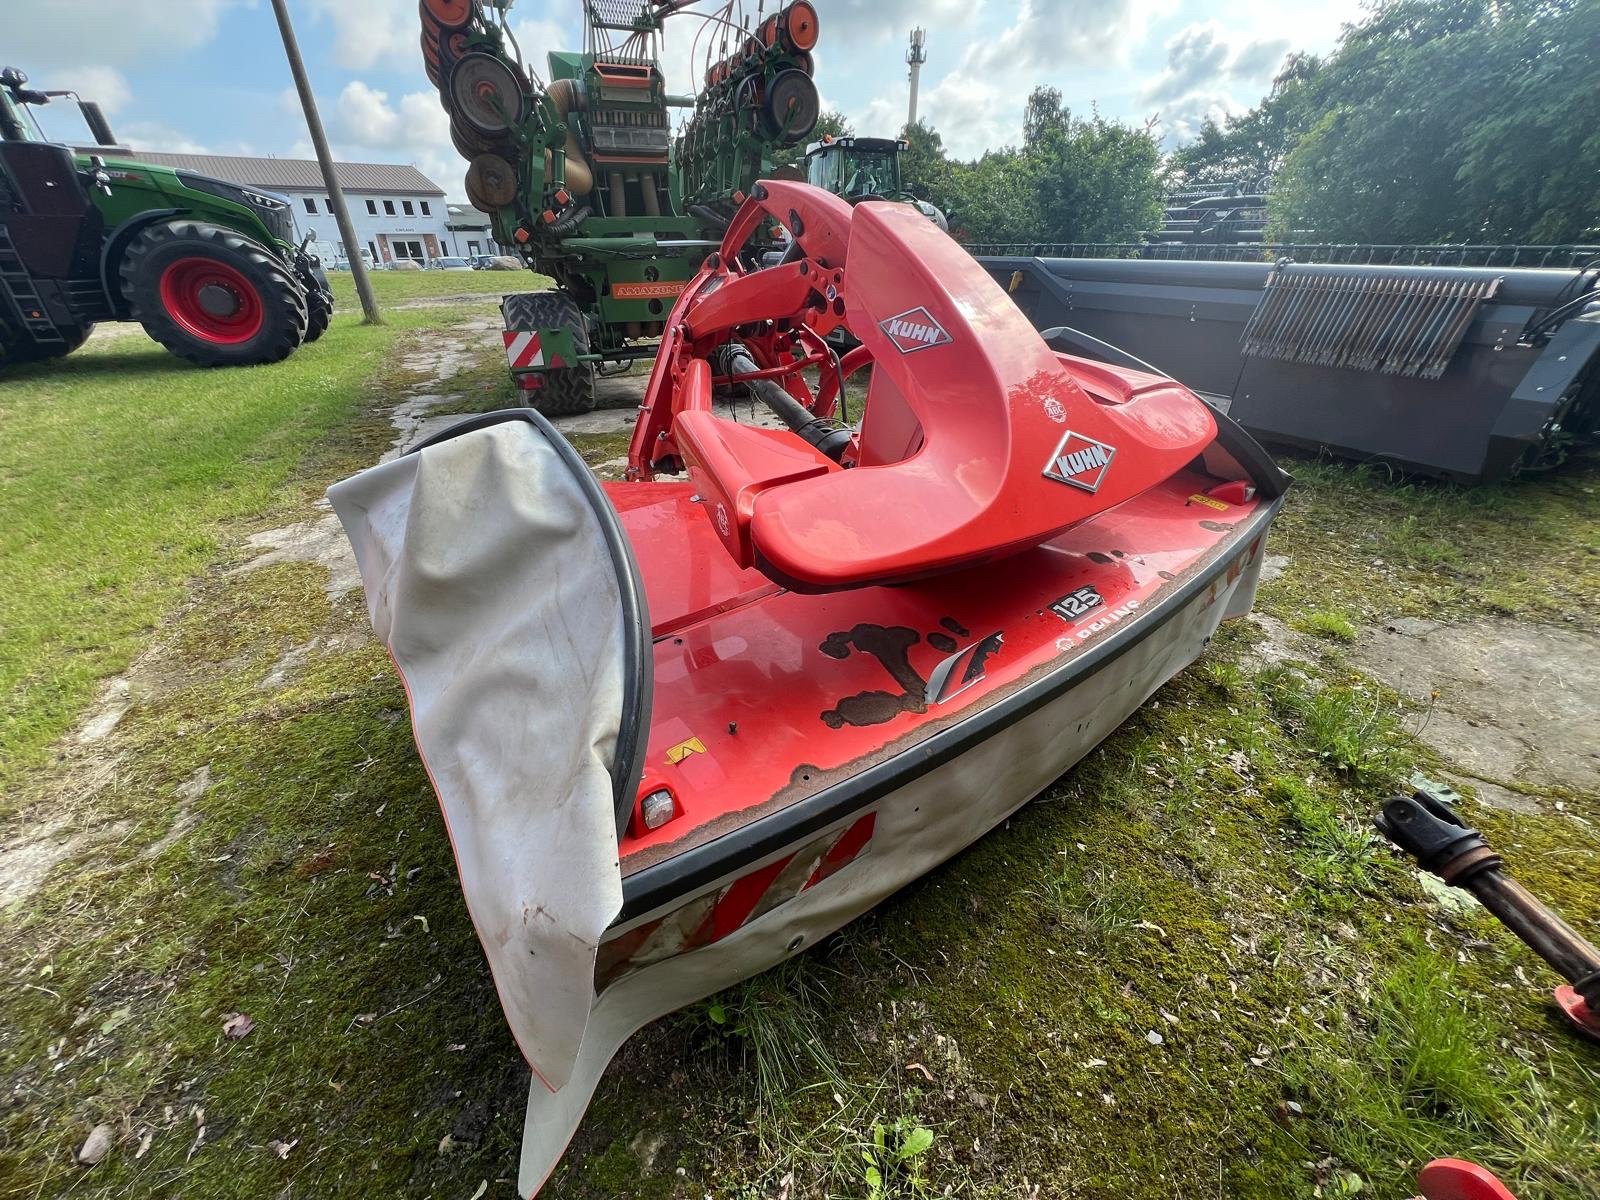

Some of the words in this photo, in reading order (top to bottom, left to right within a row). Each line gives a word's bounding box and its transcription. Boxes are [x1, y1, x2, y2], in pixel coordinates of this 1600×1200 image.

[888, 319, 940, 344] KUHN
[1055, 443, 1110, 478] KUHN
[1052, 588, 1101, 618] 125
